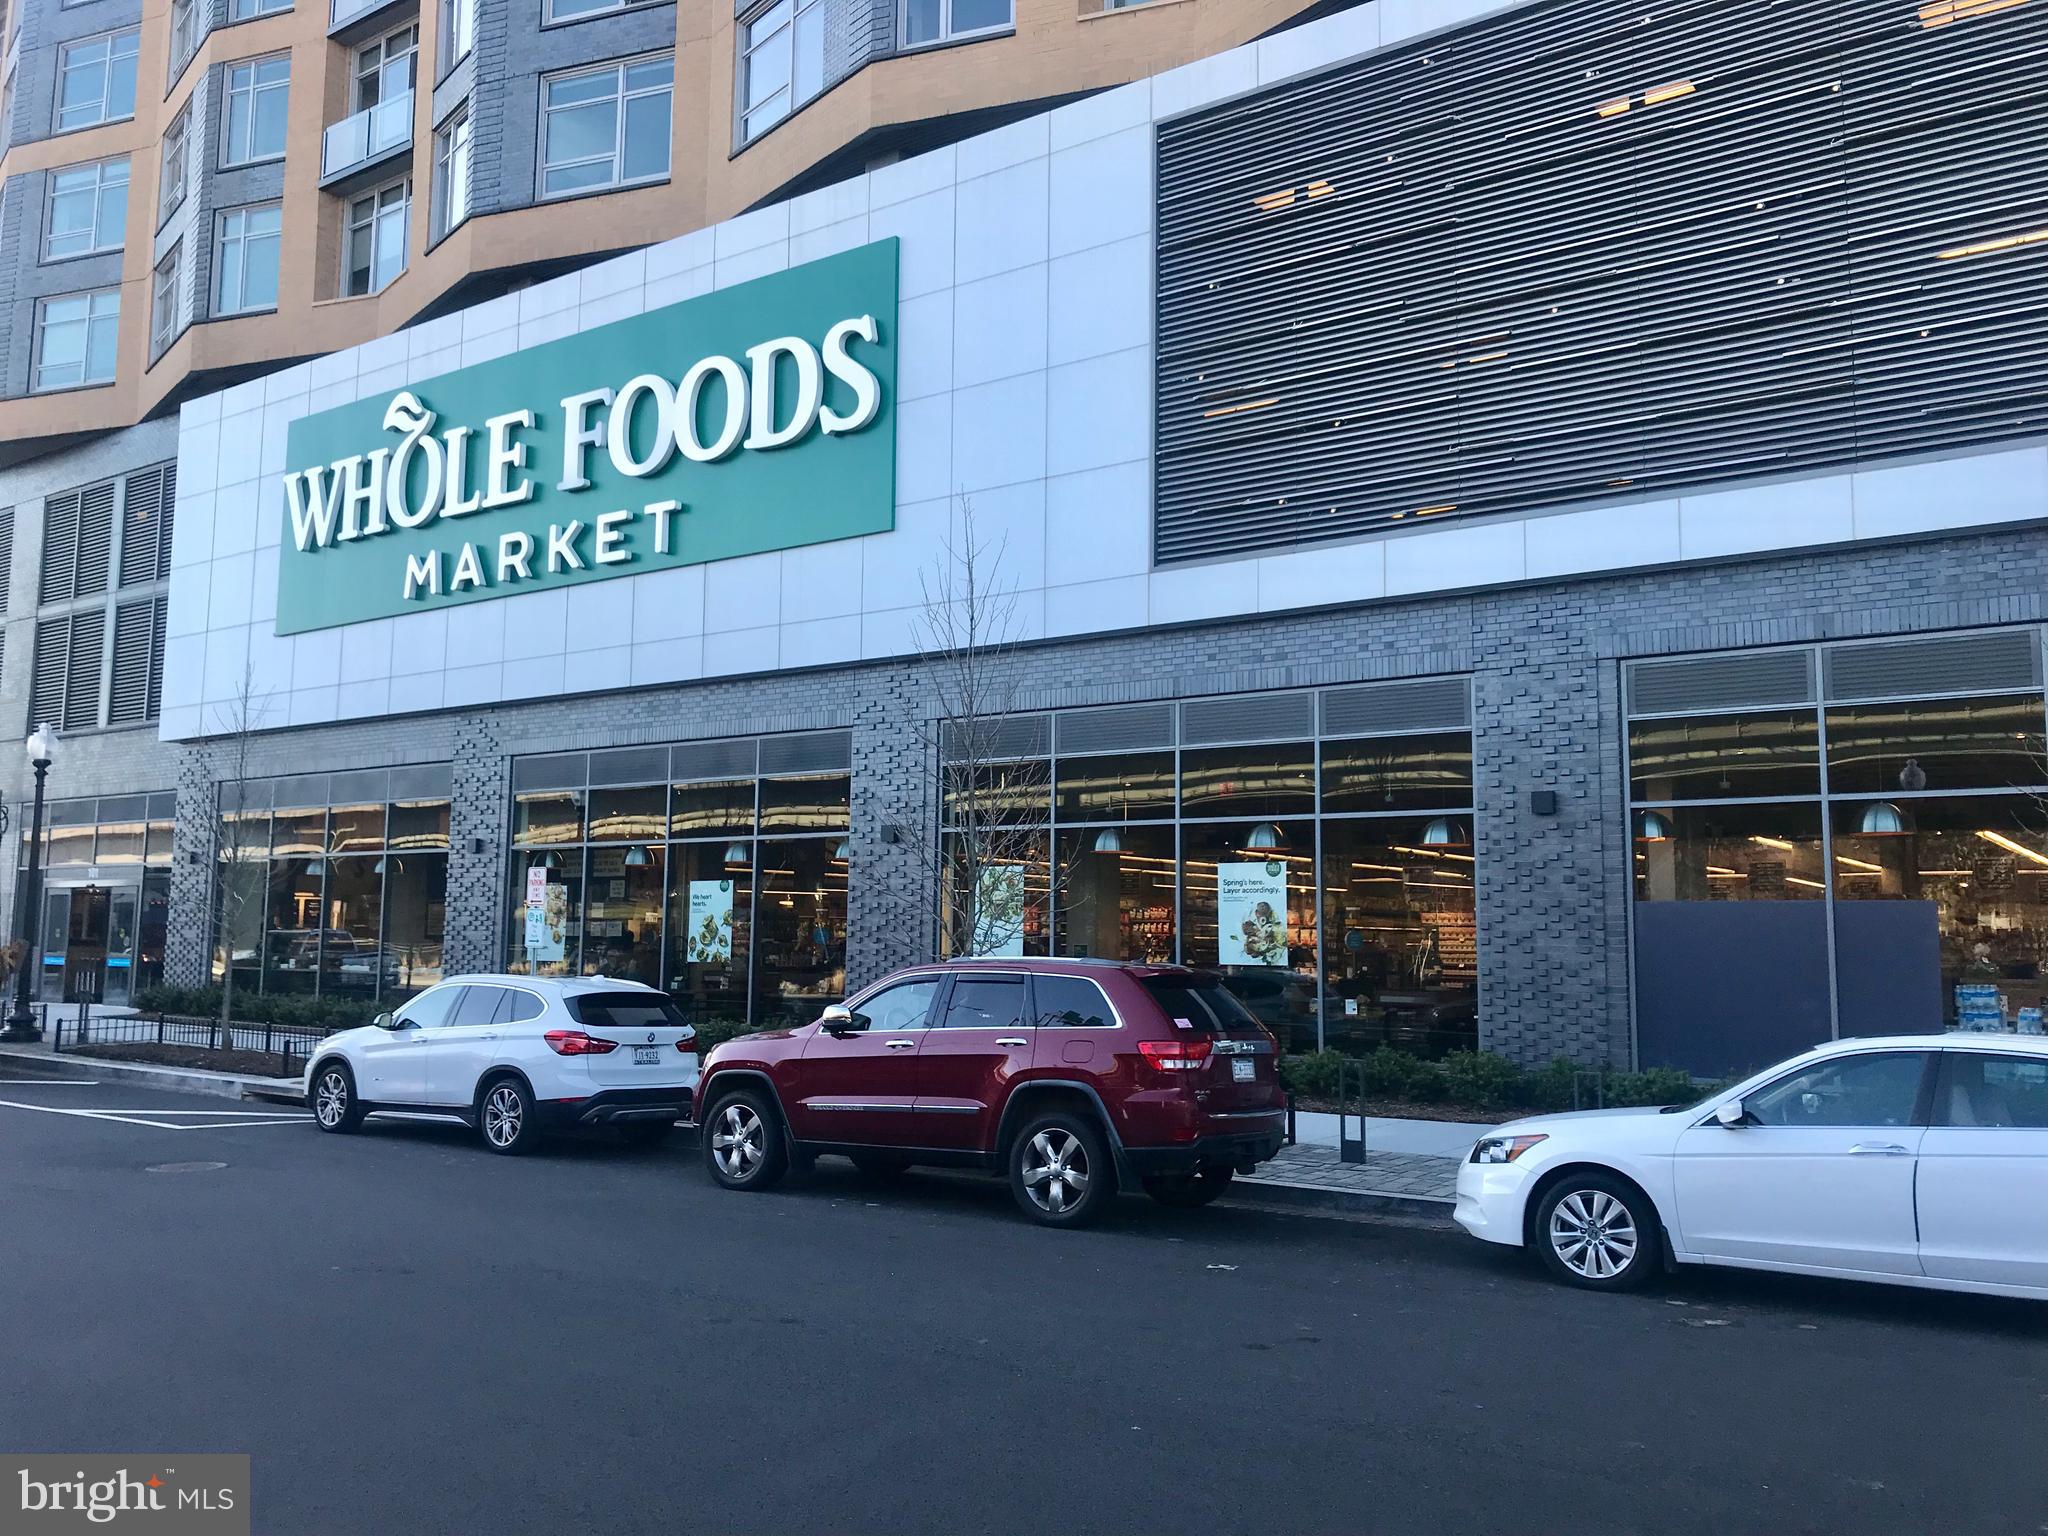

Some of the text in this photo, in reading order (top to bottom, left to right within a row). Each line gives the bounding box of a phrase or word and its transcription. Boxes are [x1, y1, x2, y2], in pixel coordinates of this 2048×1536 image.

[556, 314, 881, 493] FOODS
[403, 500, 683, 600] MARKET
[1223, 879, 1247, 887] Spring's
[1223, 886, 1281, 895] Layer accordingly.
